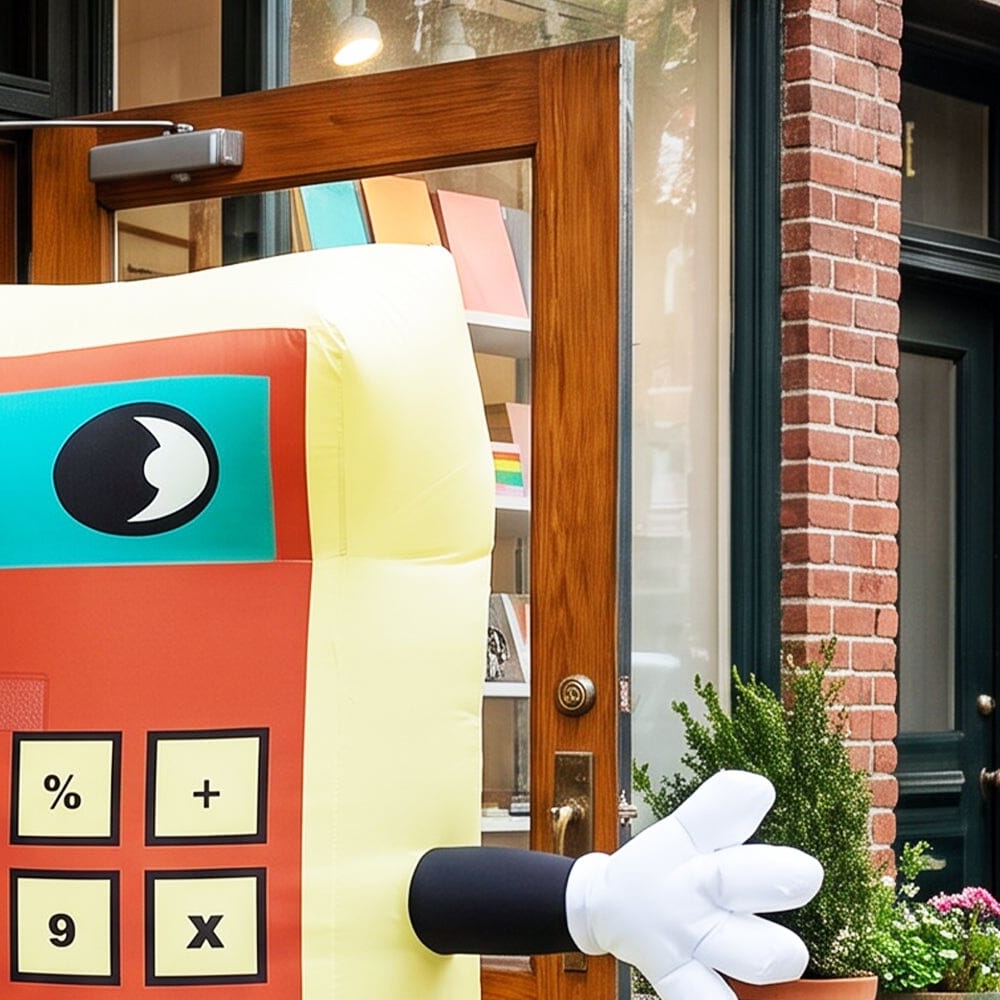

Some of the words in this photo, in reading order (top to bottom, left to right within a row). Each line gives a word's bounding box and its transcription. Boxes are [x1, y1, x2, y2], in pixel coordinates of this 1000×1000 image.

[43, 775, 82, 810] %
[192, 780, 221, 809] +
[48, 913, 76, 948] 9
